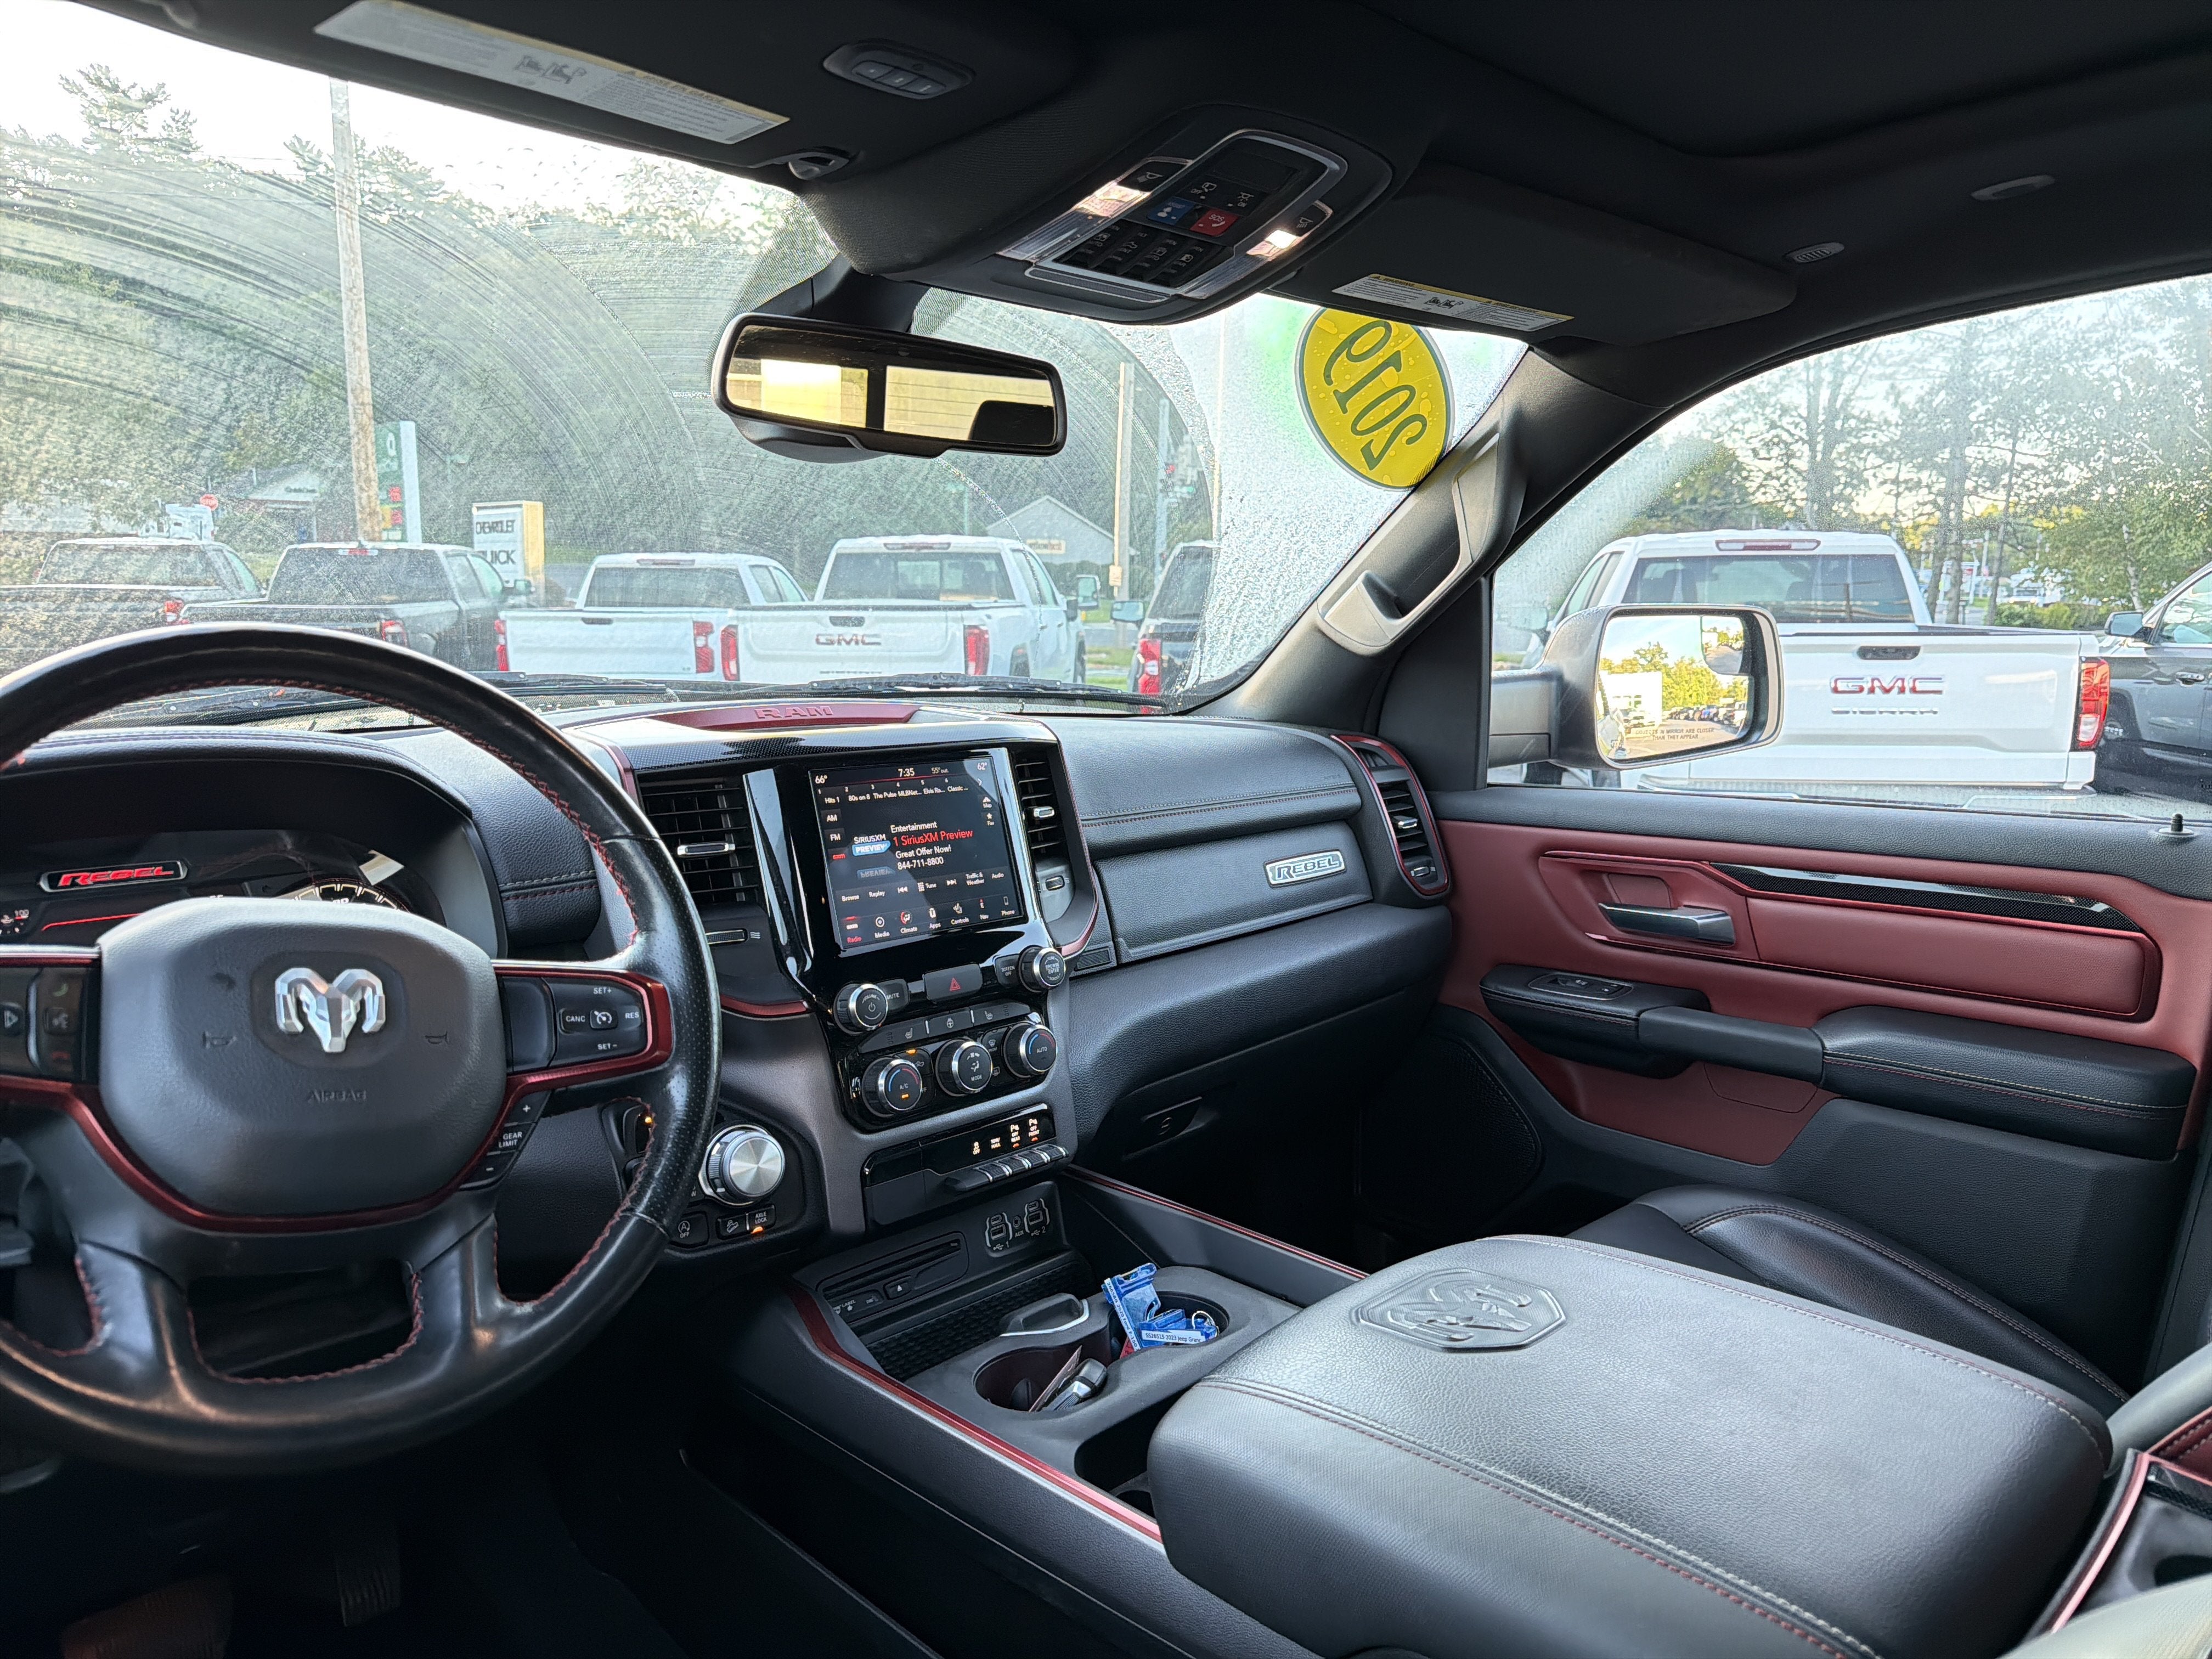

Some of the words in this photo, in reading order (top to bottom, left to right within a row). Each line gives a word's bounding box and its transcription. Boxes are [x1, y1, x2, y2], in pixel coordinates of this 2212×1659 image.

[478, 550, 516, 565] UICK
[815, 633, 882, 646] GMC
[1830, 674, 1945, 695] GMC
[754, 706, 833, 719] RAM
[898, 768, 915, 777] 7:35
[890, 821, 938, 833] Entertainment
[854, 834, 886, 844] SIRIUSXM
[893, 837, 898, 847] 1
[901, 831, 939, 846] SiriusXM
[940, 830, 973, 840] Preview
[855, 843, 888, 853] PREVIEW
[895, 850, 915, 859] Great
[916, 847, 933, 856] Offer
[934, 844, 951, 854] Now!
[898, 856, 944, 870] 844-711-8800
[1276, 856, 1339, 881] REBEL
[57, 866, 174, 887] REBEL
[951, 917, 969, 925] Controls
[503, 1131, 522, 1140] GEAR
[498, 1139, 518, 1148] LIMIT
[842, 1300, 856, 1308] LABEL
[1116, 1304, 1125, 1317] 2020
